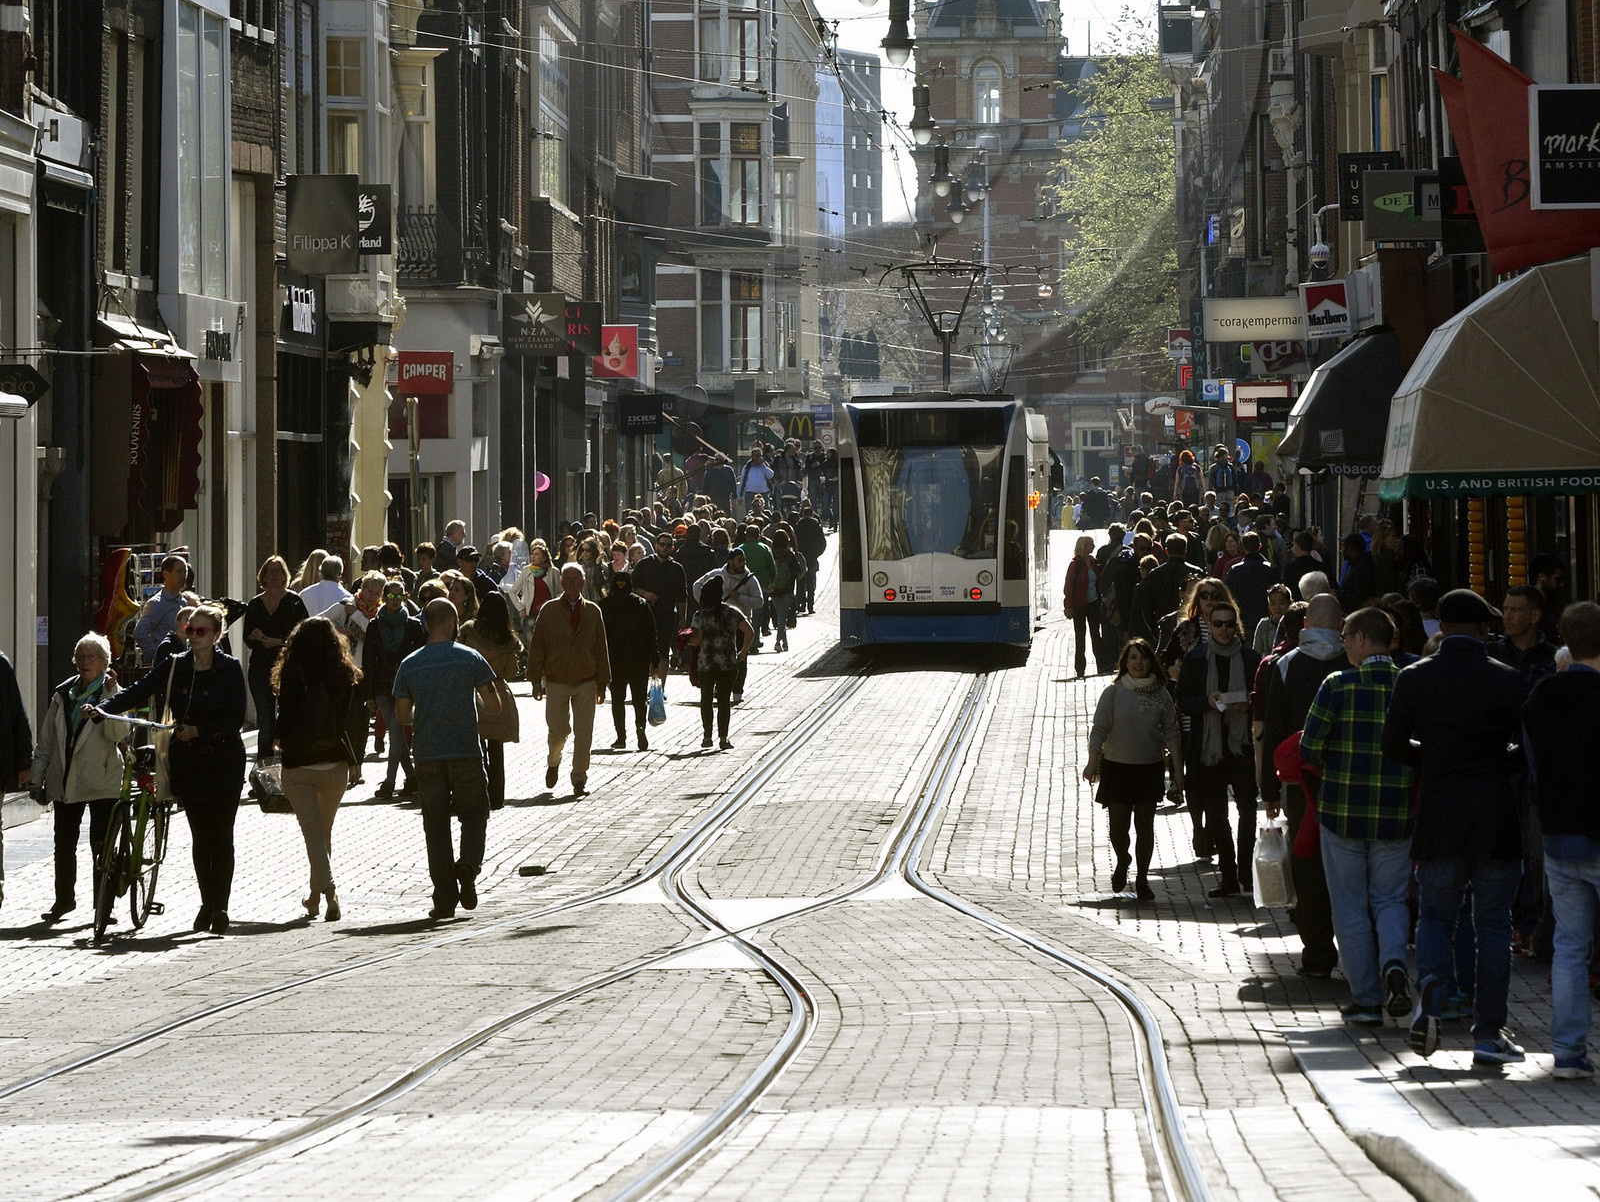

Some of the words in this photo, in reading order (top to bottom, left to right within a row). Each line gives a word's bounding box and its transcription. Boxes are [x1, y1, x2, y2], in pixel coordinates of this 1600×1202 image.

[293, 234, 338, 253] Filippa
[340, 234, 351, 249] K
[1308, 309, 1348, 326] Marlboro
[403, 363, 446, 381] CAMPER
[627, 414, 656, 422] IKKS
[128, 403, 142, 465] SOUVENIRS
[1425, 480, 1454, 490] U.S.
[1459, 479, 1493, 489] AND
[1497, 477, 1555, 488] BRITISH
